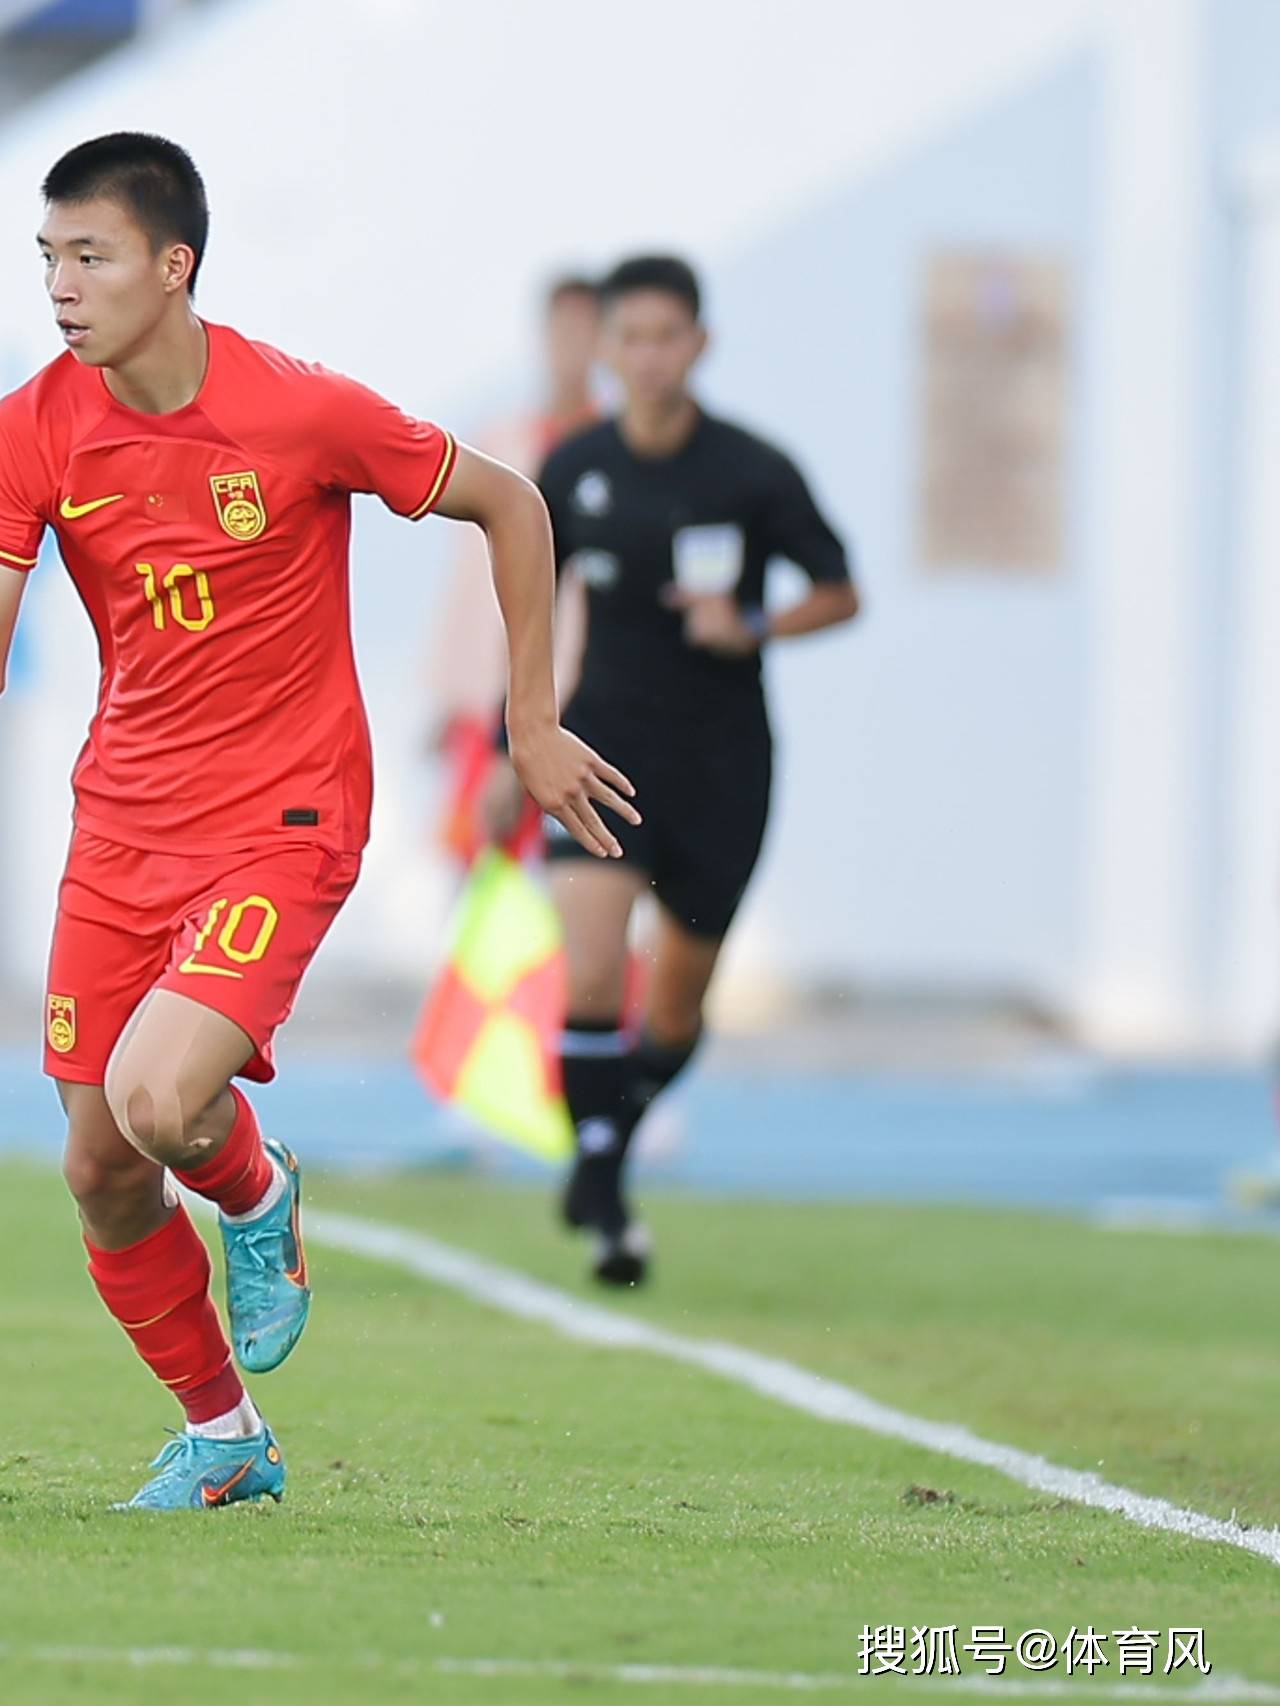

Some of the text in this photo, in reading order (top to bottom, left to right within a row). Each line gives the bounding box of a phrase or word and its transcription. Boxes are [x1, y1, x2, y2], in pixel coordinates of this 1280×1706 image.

[214, 477, 253, 493] CFA
[135, 563, 215, 631] 10
[194, 894, 278, 964] 10
